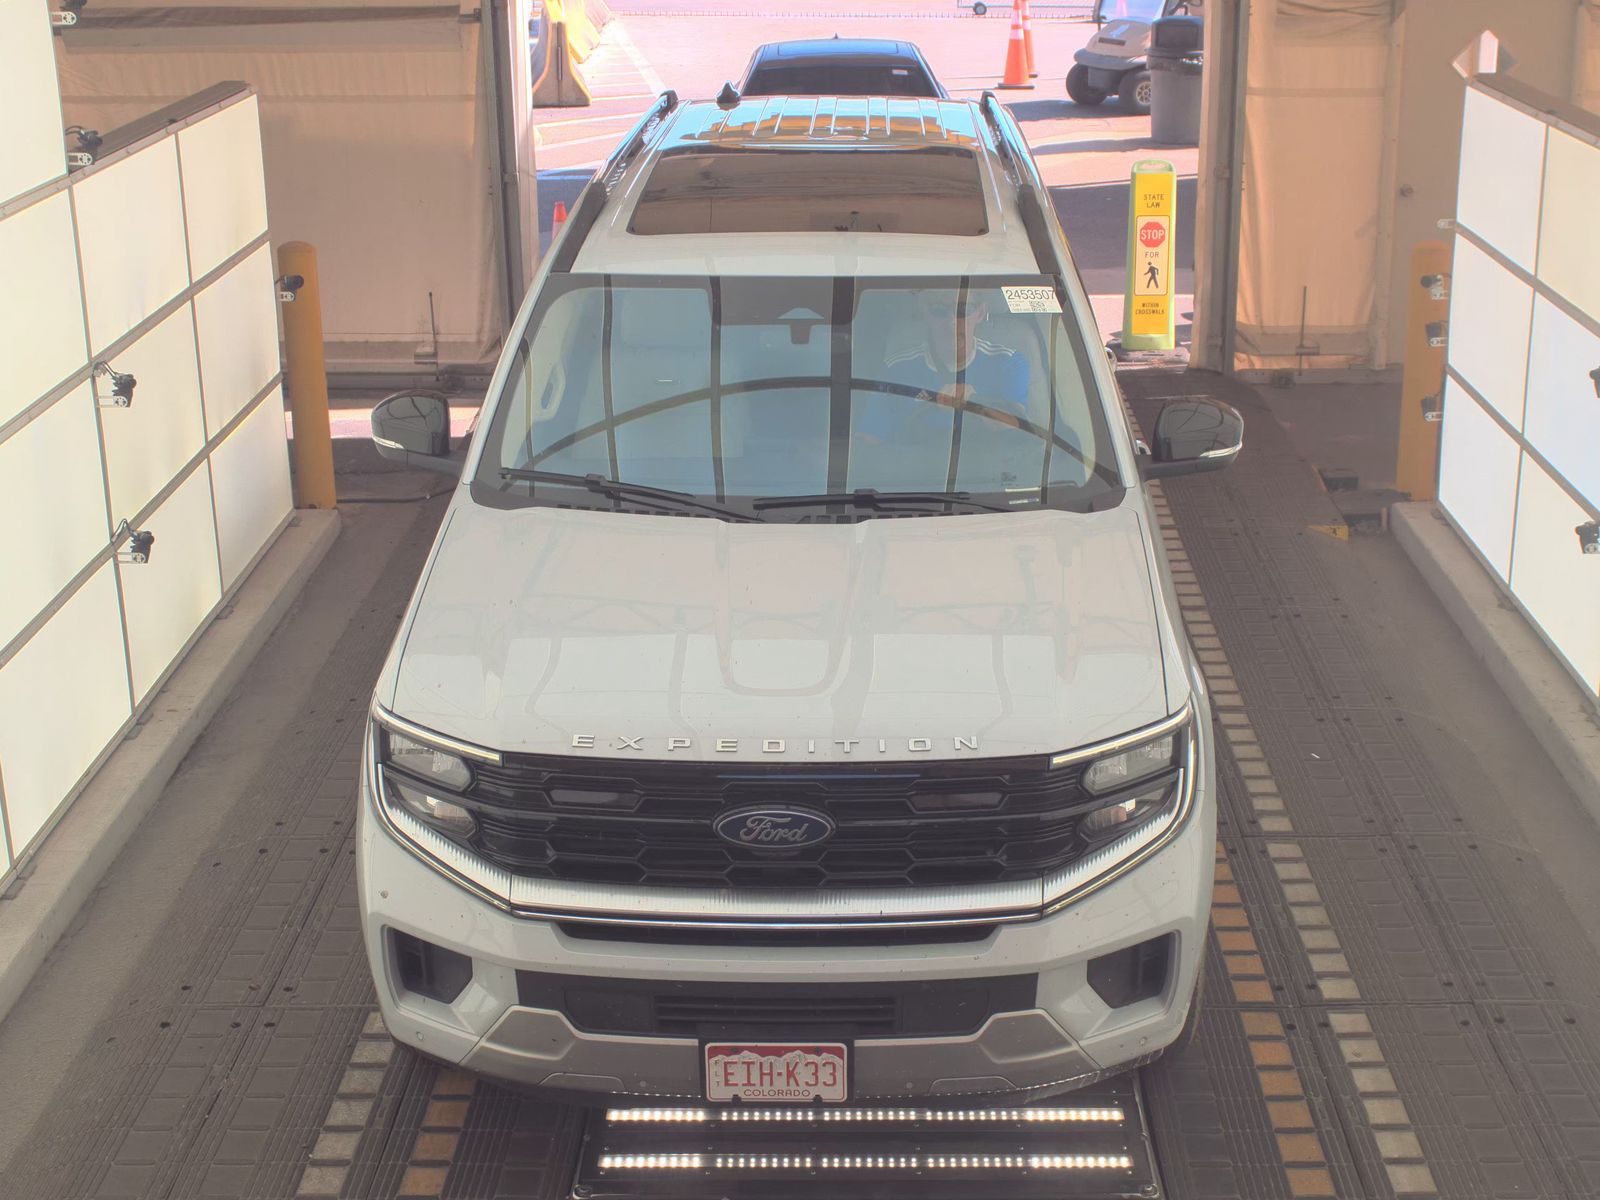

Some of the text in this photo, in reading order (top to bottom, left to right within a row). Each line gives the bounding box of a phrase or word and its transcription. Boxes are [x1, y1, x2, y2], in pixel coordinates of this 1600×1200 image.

[1143, 193, 1165, 201] STATE
[1141, 229, 1165, 240] STOP
[1006, 289, 1056, 300] 2453507
[571, 734, 979, 754] EXPEDITION
[740, 815, 809, 841] Ford
[743, 1088, 811, 1097] COLORADO
